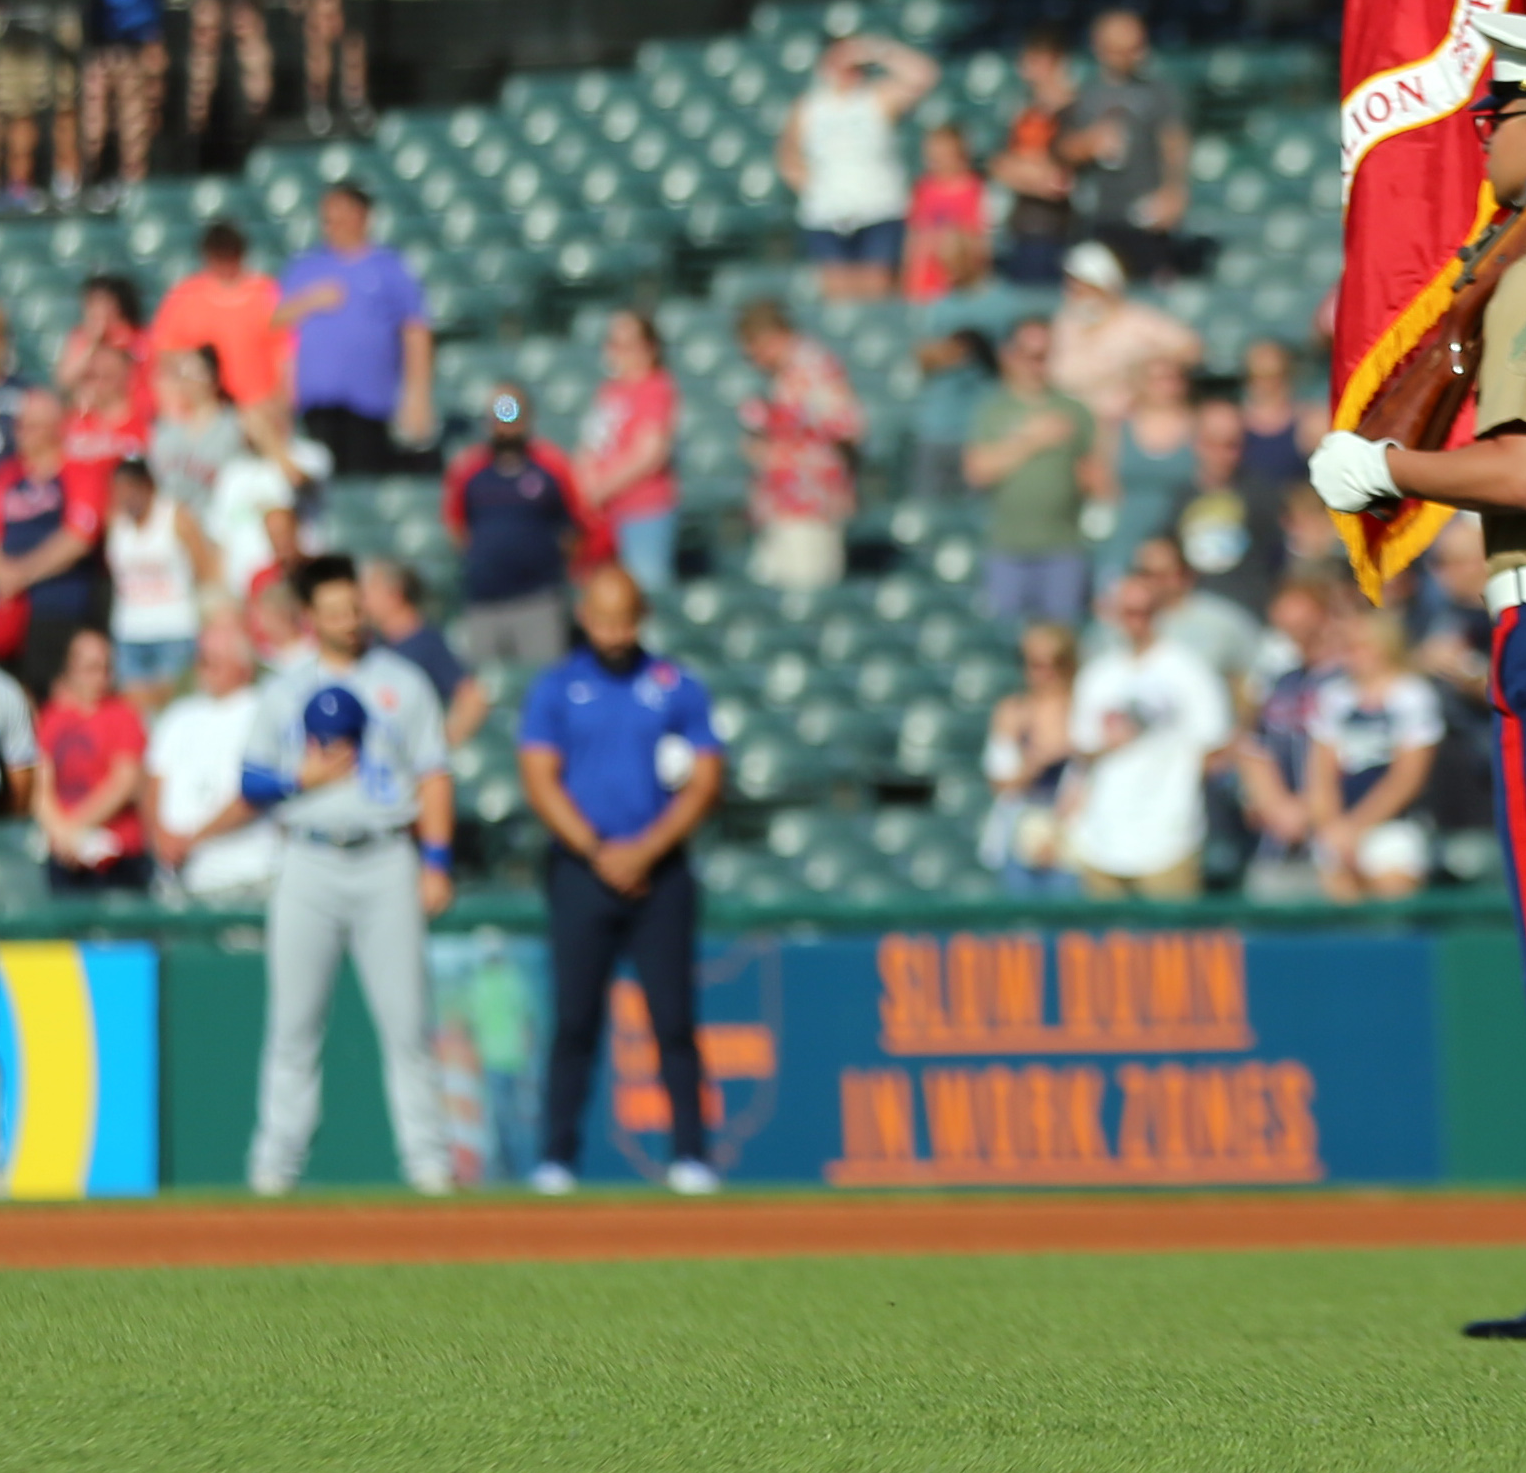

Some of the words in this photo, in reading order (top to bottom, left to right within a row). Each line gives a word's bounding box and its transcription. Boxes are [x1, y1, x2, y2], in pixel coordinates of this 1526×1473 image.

[878, 933, 1043, 1045] SLOW
[1058, 930, 1247, 1043] DOWN
[841, 1065, 914, 1175] IN
[922, 1064, 1108, 1172] WORK
[1116, 1059, 1318, 1172] ZONES
